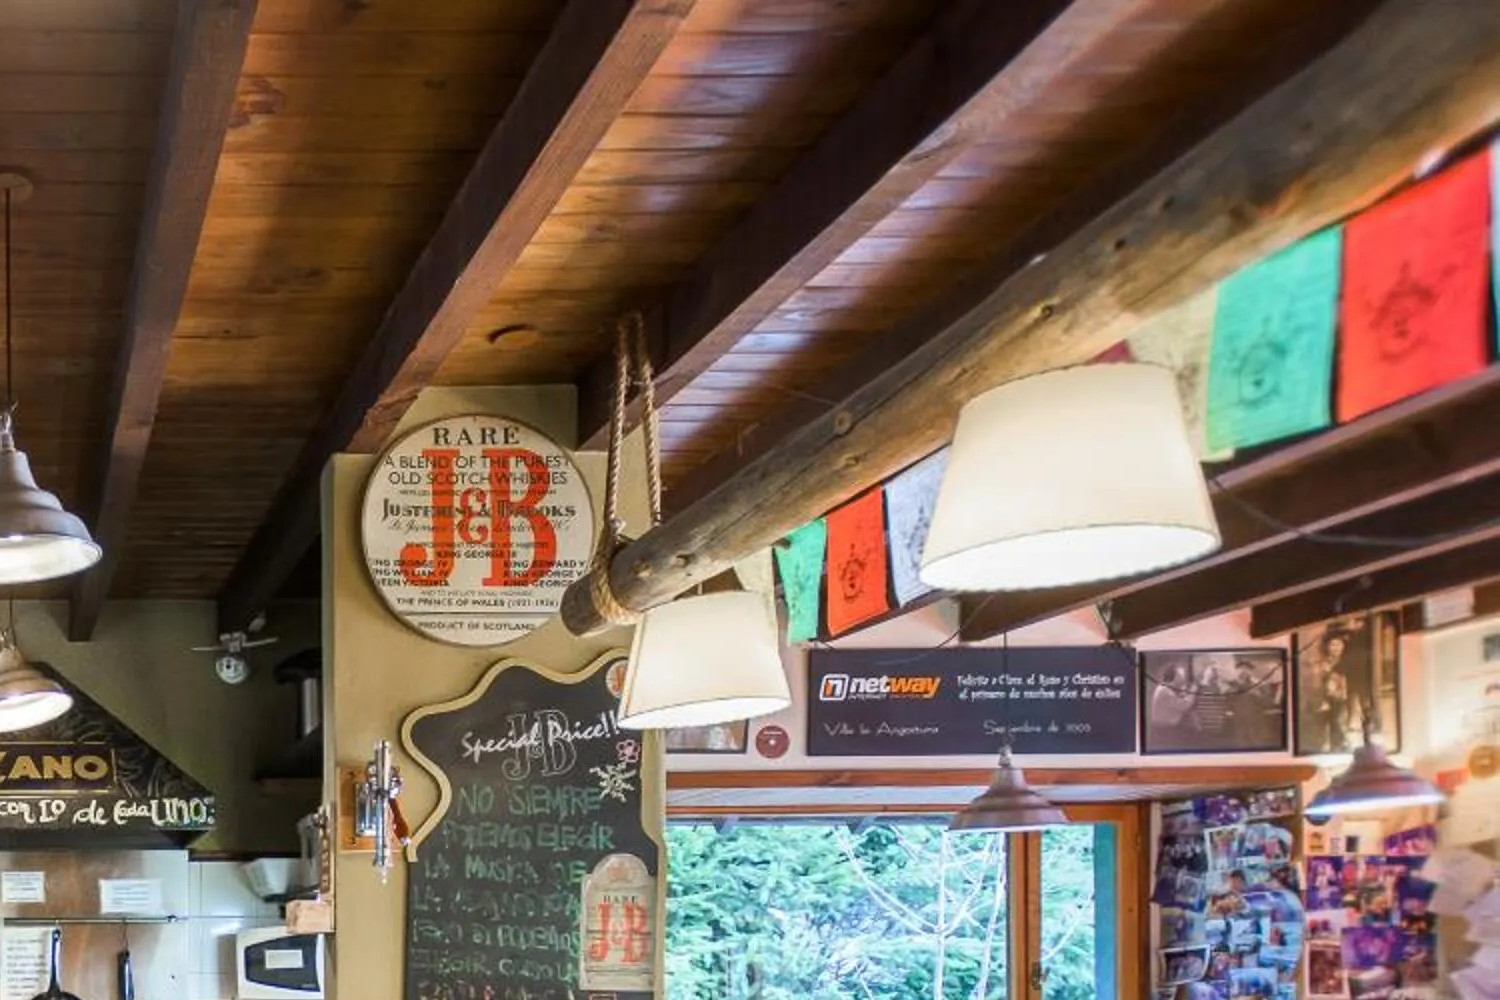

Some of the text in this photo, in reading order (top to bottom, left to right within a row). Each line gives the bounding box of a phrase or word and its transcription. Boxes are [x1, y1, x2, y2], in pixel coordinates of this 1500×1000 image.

[433, 427, 520, 446] RARE
[385, 456, 569, 469] A BLEND OF THE PUREST
[388, 471, 568, 485] OLD SCOTCH WHISKIES
[399, 448, 557, 587] J&B
[417, 598, 452, 607] PRINCE
[455, 598, 469, 607] OF
[471, 598, 505, 608] WALES
[418, 621, 536, 632] PRODUCT OF SCOTLAND
[850, 675, 941, 699] netway
[461, 720, 541, 764] Special
[72, 799, 110, 825] de
[457, 783, 602, 821] NO SIEMPRE
